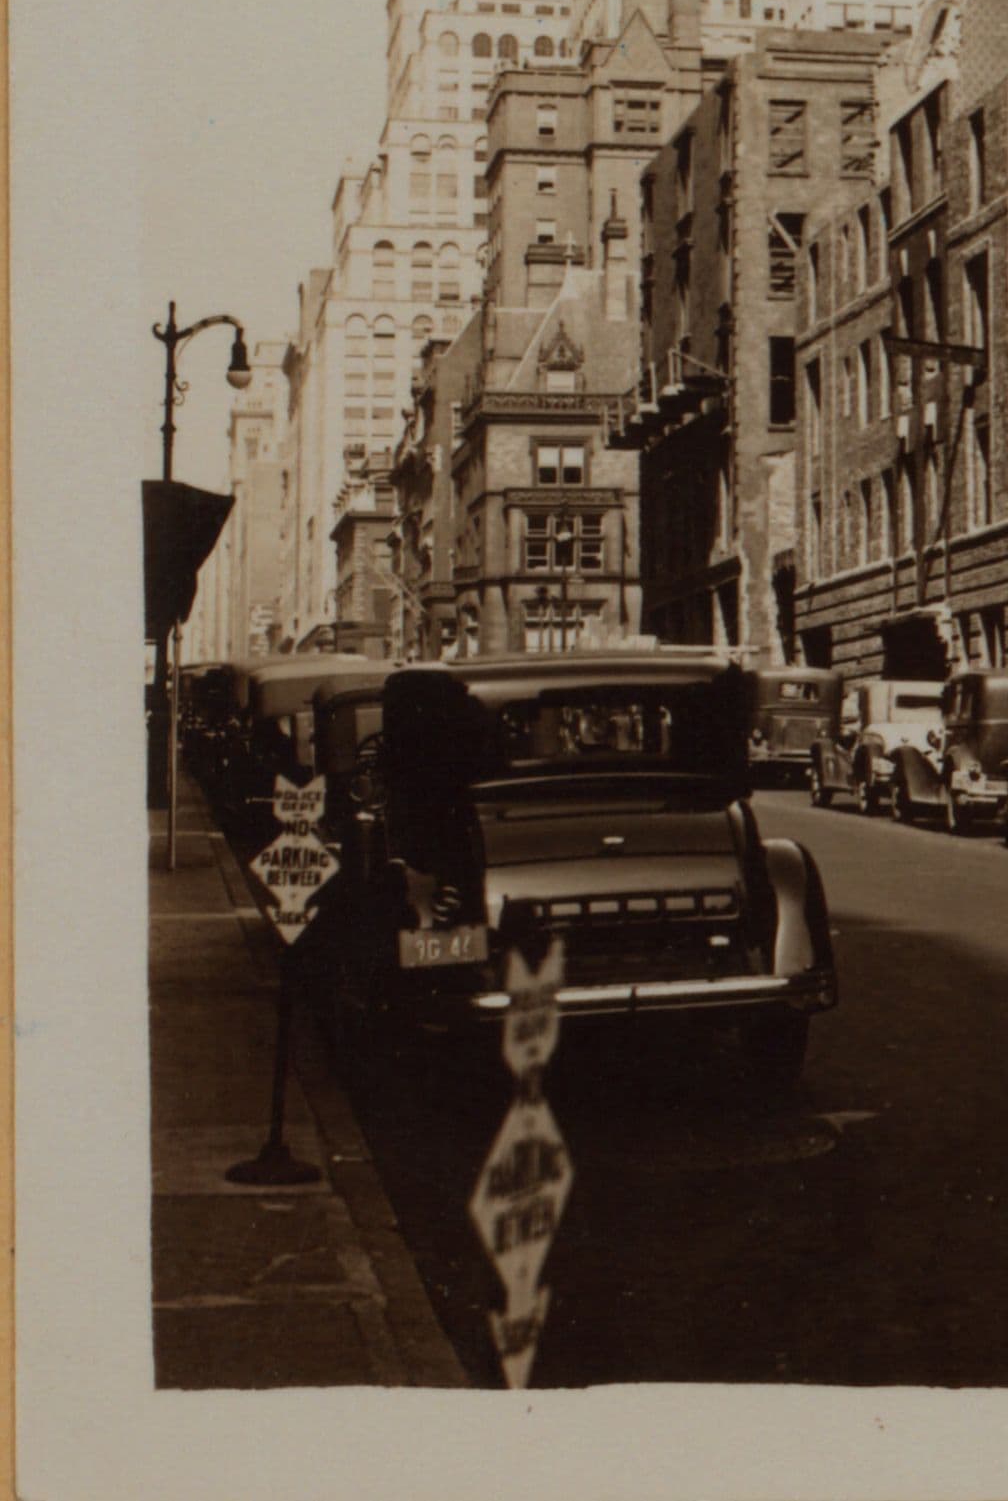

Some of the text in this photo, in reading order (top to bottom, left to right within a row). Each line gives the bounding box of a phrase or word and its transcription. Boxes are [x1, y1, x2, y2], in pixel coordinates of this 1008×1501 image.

[275, 790, 322, 802] POLICE
[286, 820, 309, 837] NO
[260, 846, 330, 869] PARKING
[266, 869, 322, 887] BETWEEN
